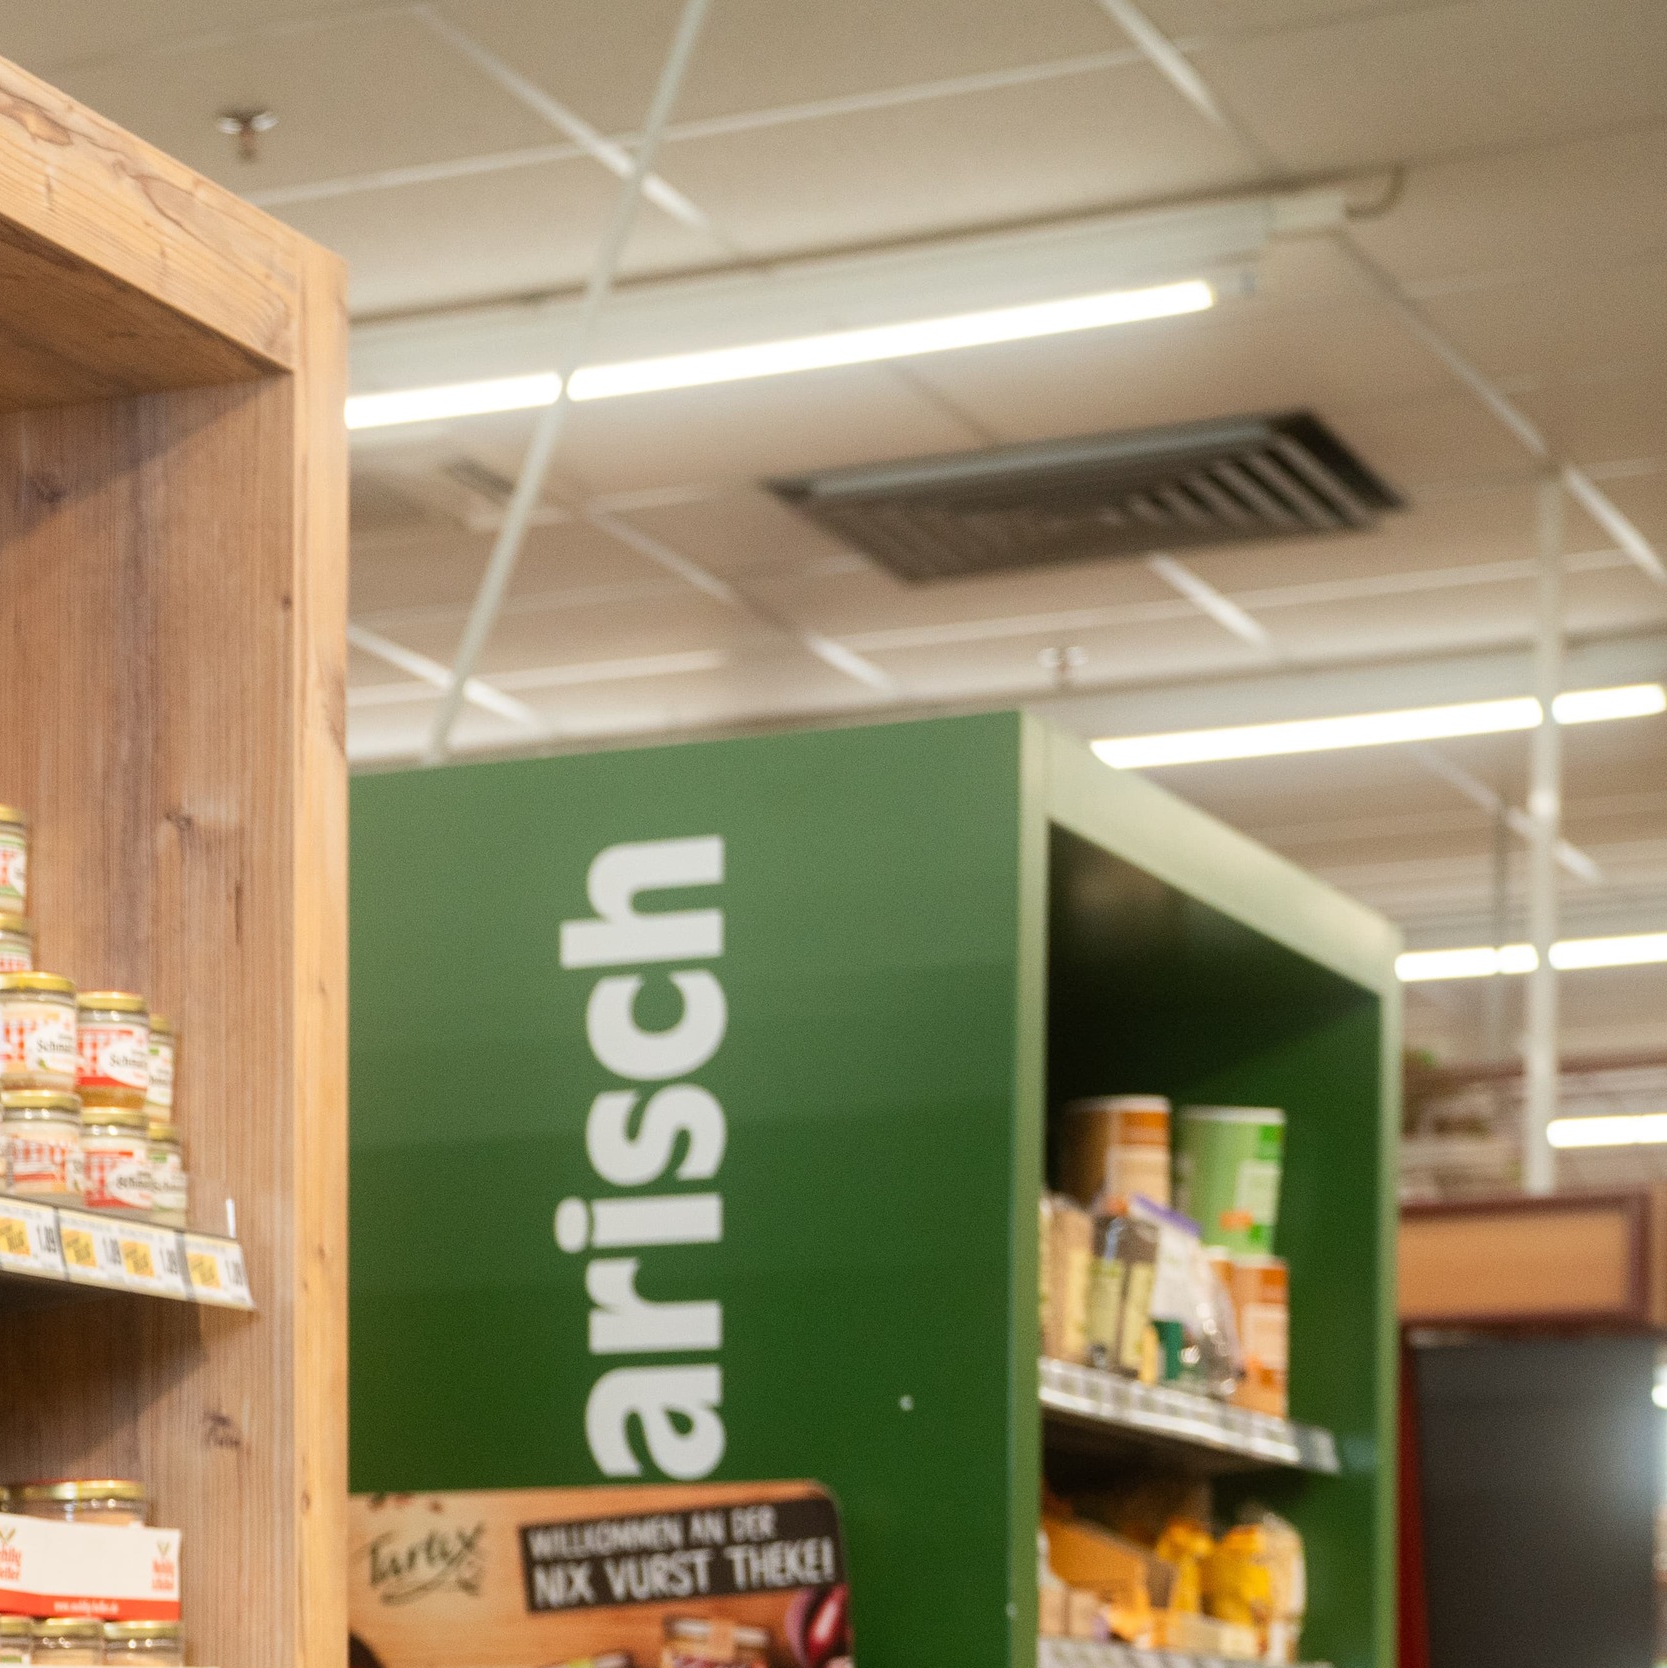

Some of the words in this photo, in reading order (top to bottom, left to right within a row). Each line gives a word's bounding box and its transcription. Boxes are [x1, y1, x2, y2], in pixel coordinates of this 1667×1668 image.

[554, 834, 727, 1480] arisch
[528, 1514, 683, 1560] WILLKOMMEN
[689, 1511, 726, 1545] AN
[532, 1560, 595, 1602] NIX
[603, 1547, 714, 1599] VURST
[724, 1535, 835, 1588] THEKE!
